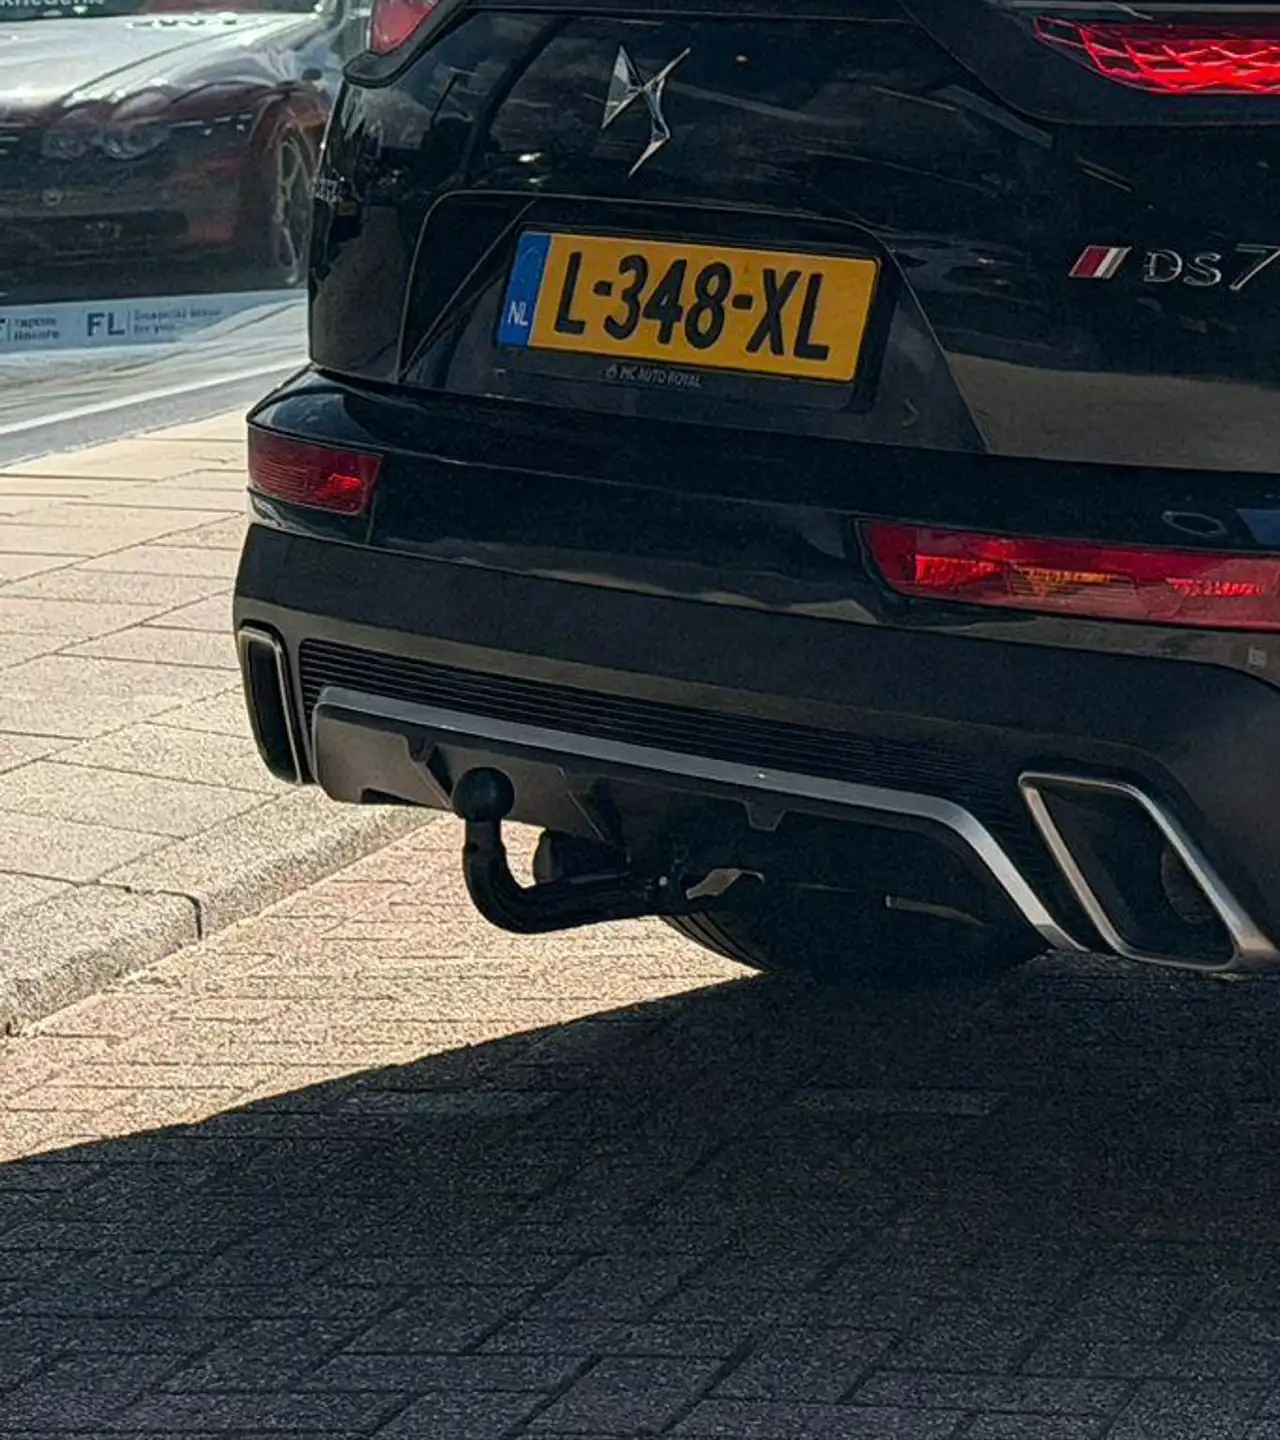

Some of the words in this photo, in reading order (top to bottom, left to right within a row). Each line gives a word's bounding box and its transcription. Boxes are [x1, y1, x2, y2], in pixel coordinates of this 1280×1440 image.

[507, 299, 529, 327] NL
[553, 250, 830, 361] L-348-XL
[86, 312, 125, 337] FL
